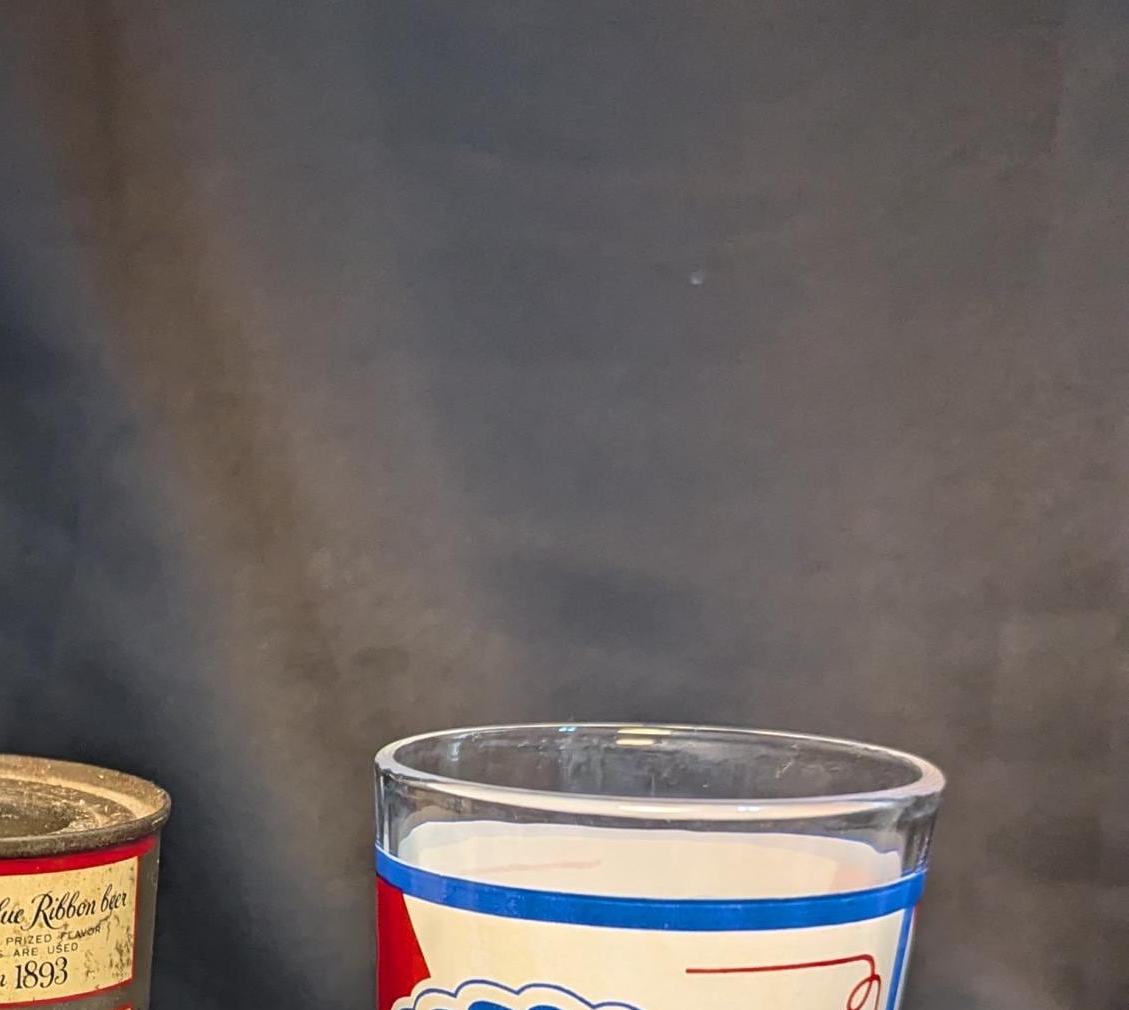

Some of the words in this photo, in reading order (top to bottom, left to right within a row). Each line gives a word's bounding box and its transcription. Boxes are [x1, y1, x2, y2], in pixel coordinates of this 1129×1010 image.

[20, 890, 96, 931] Ribbon
[100, 883, 127, 912] beer
[6, 934, 52, 945] PRIZED
[60, 925, 102, 940] FLAVOR
[13, 947, 38, 957] ARE
[47, 942, 78, 955] USED
[15, 956, 68, 989] 1893
